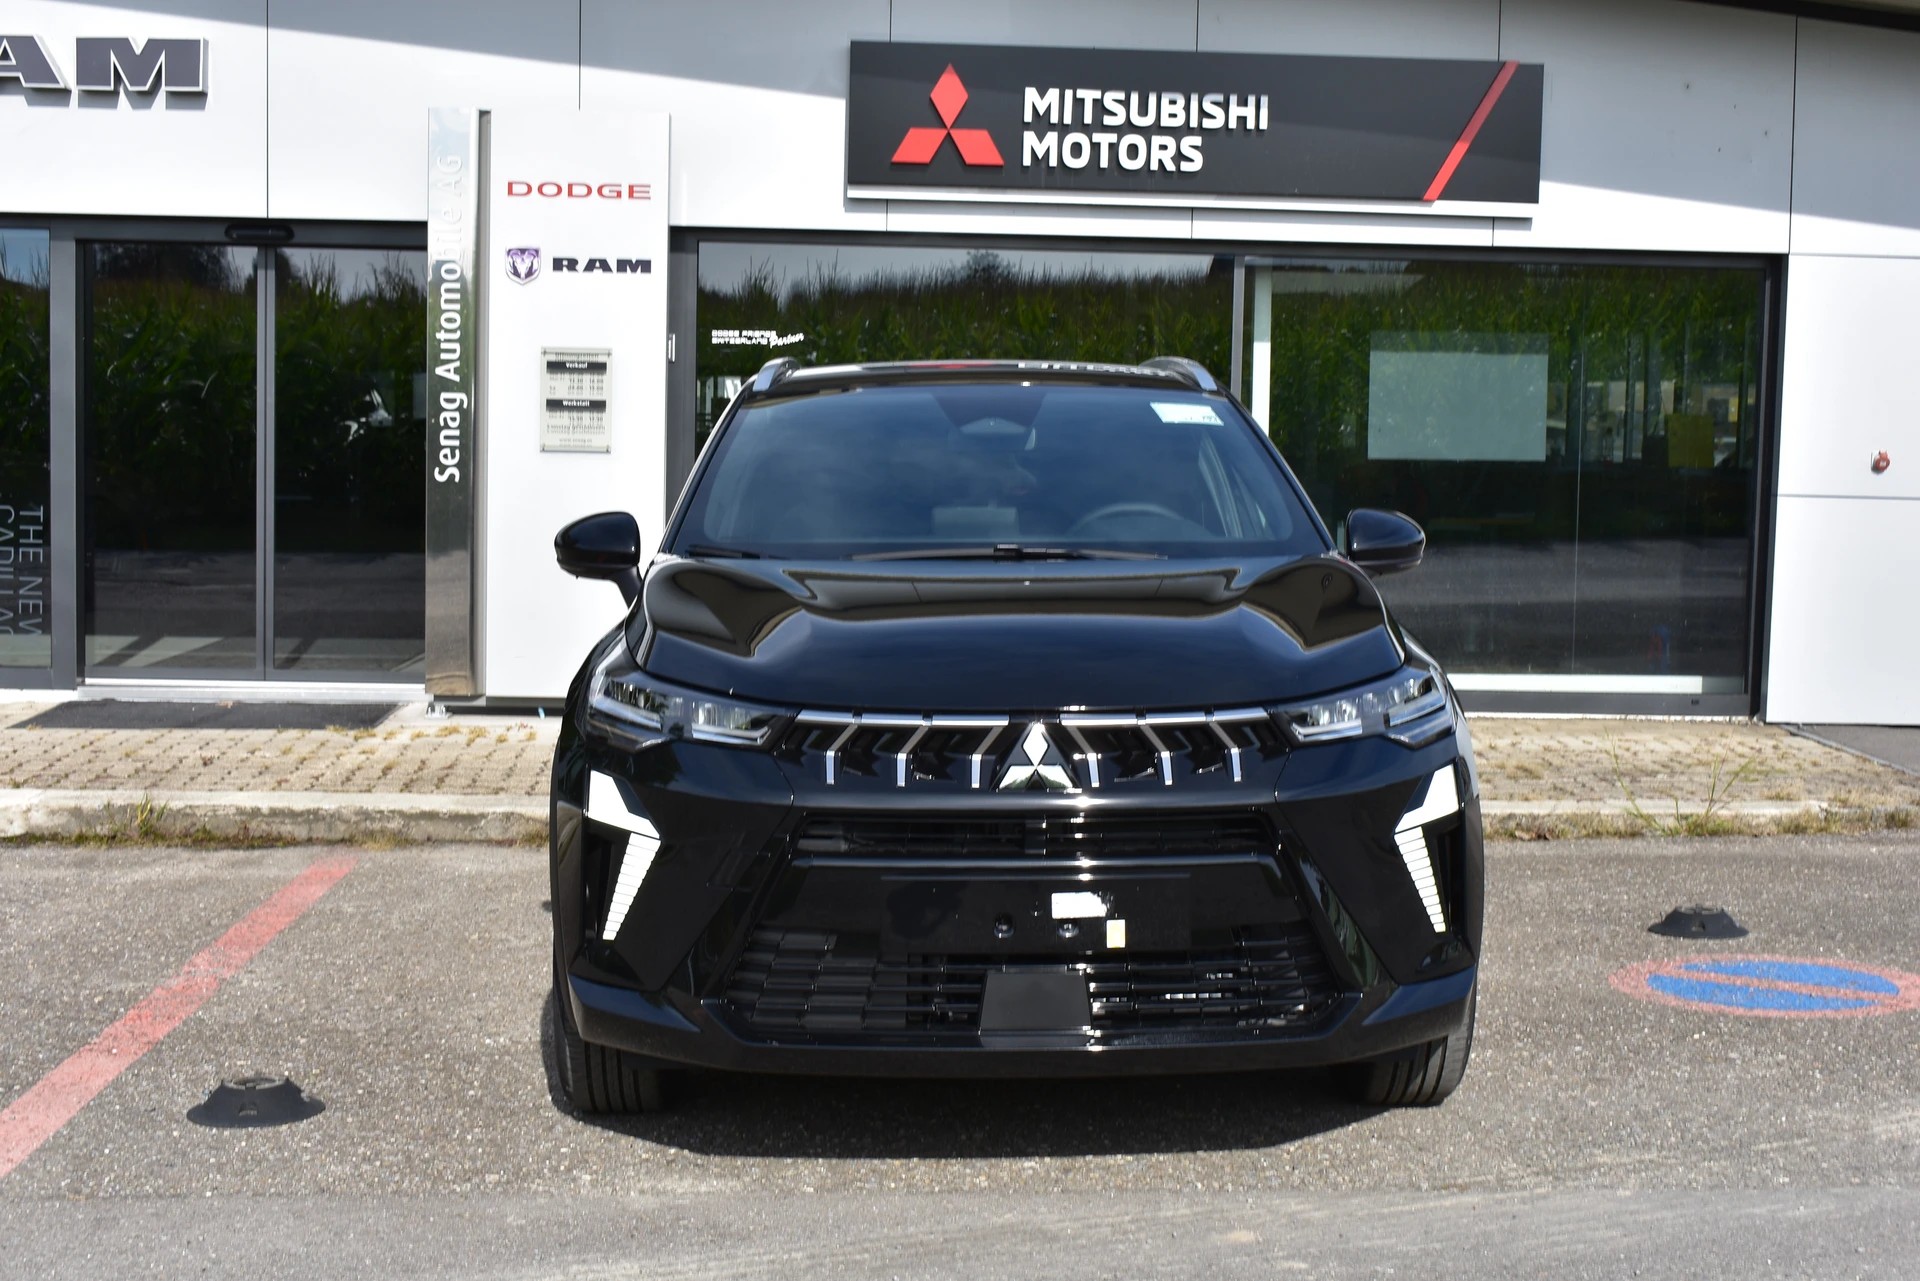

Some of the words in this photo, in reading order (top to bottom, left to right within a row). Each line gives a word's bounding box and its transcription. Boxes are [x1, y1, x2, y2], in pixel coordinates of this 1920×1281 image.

[1023, 86, 1269, 130] MITSUBISHI
[1022, 130, 1204, 172] MOTORS
[507, 181, 651, 200] DODGE
[552, 257, 652, 274] RAM
[434, 207, 463, 382] Automobile
[434, 391, 468, 483] Senag
[19, 505, 44, 563] THE
